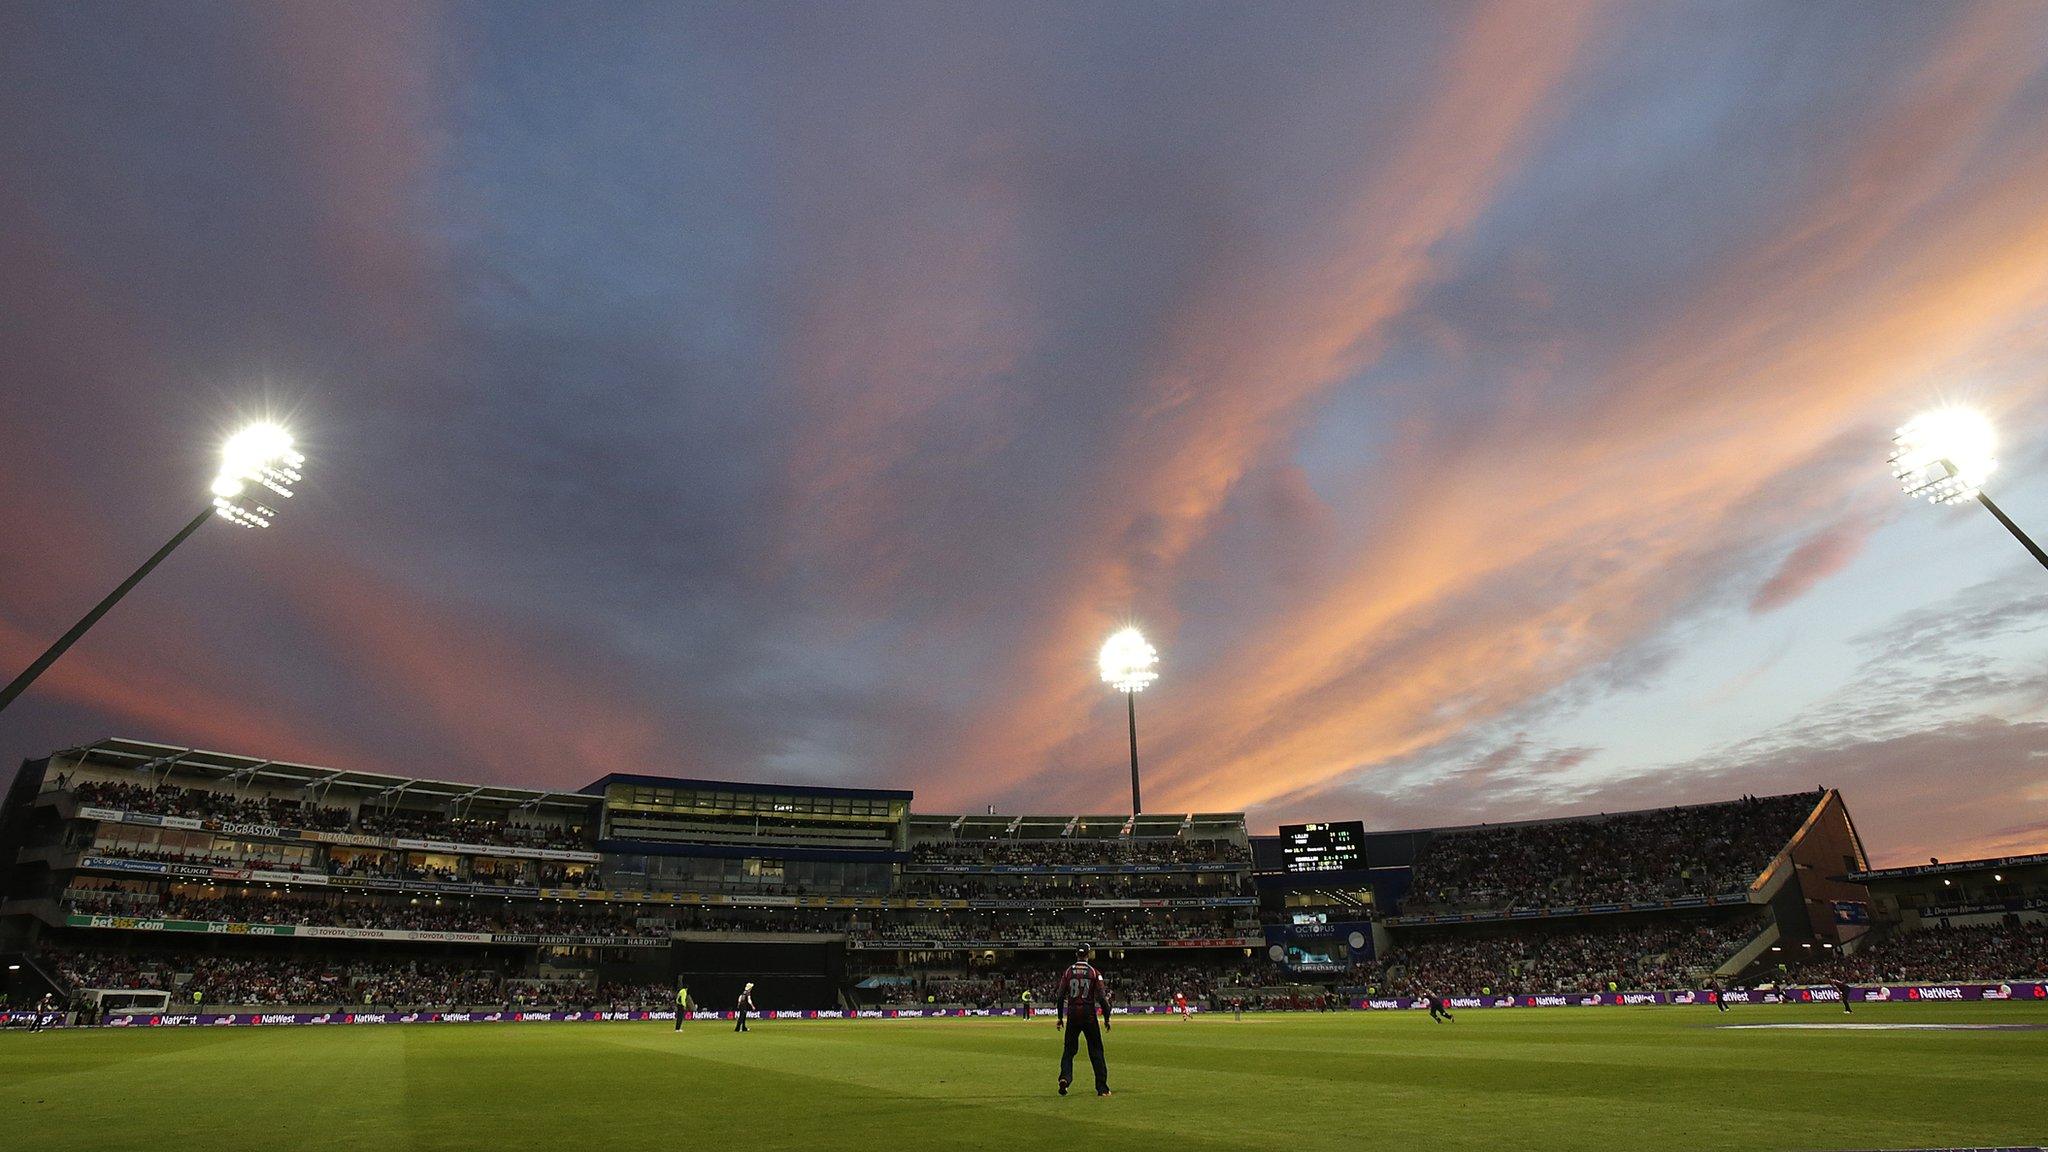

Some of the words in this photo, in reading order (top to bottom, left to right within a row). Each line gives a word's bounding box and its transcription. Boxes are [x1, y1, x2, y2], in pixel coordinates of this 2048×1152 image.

[222, 823, 281, 837] EDGBASTON
[318, 832, 379, 847] BIRMINGHAM
[180, 866, 209, 875] KUKRI
[90, 915, 165, 930] bet365.com
[207, 921, 275, 935] bet365.com
[1295, 925, 1335, 933] OCTOPUS
[1070, 978, 1089, 998] 87
[1918, 986, 1963, 1000] NatWest
[1722, 991, 1750, 1002] atWest
[1810, 988, 1840, 1001] NatWe
[1369, 1000, 1398, 1009] NatWest
[1450, 998, 1481, 1007] NatWest
[1535, 996, 1567, 1006] NatWest
[261, 1014, 295, 1024] NatWest
[354, 1013, 385, 1023] NatWest
[522, 1012, 550, 1021] NatWest
[649, 1011, 676, 1019] NatWest
[692, 1011, 719, 1019] NatWest
[776, 1010, 802, 1019] NatWest
[817, 1010, 843, 1018] NatWest
[857, 1010, 883, 1018] NatWest
